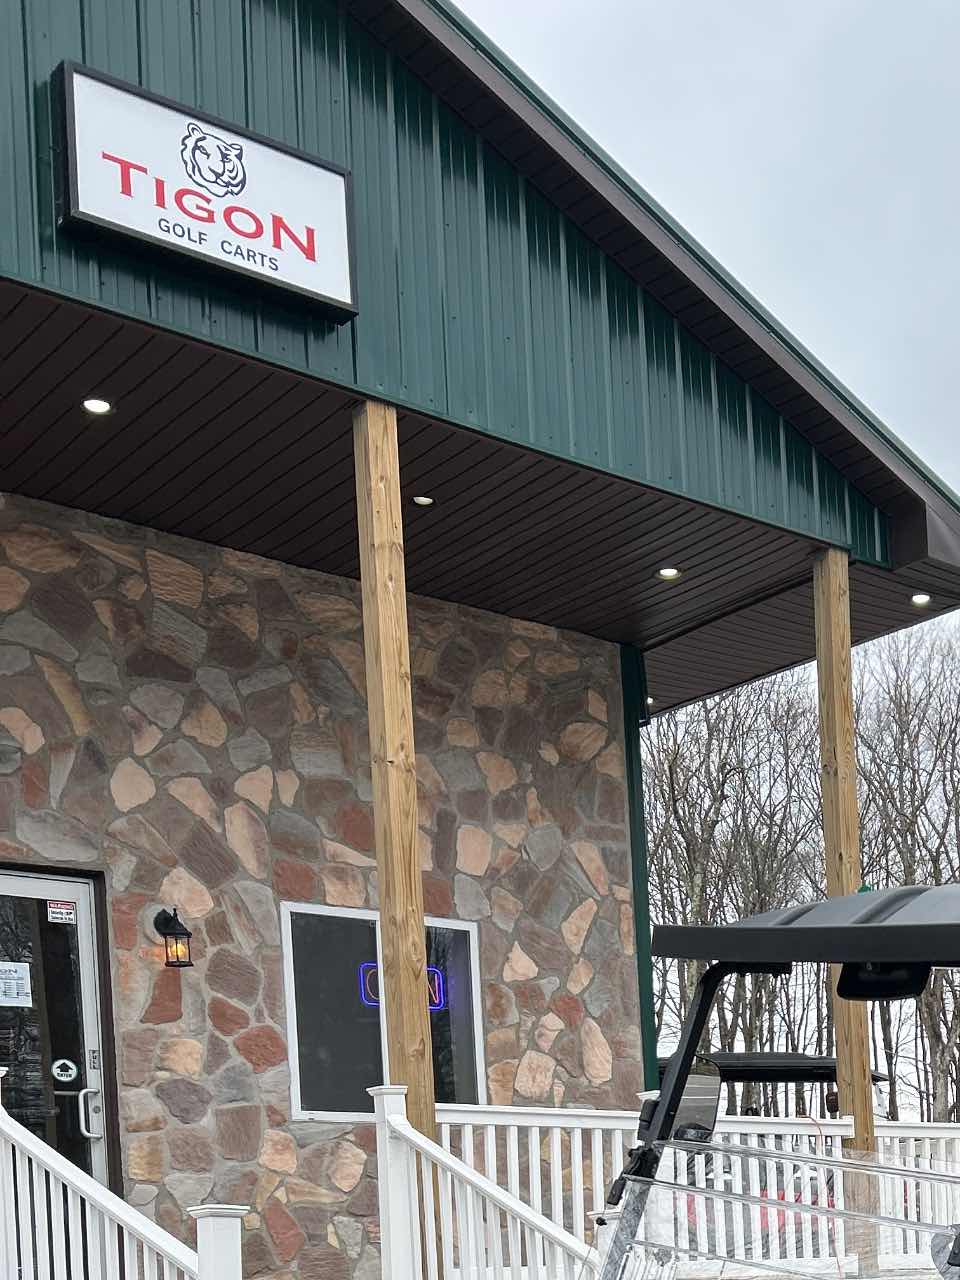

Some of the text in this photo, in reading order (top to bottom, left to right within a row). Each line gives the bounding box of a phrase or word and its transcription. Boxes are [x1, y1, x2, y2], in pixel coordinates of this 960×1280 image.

[101, 151, 317, 263] TIGON
[158, 217, 280, 272] GOLF CARTS
